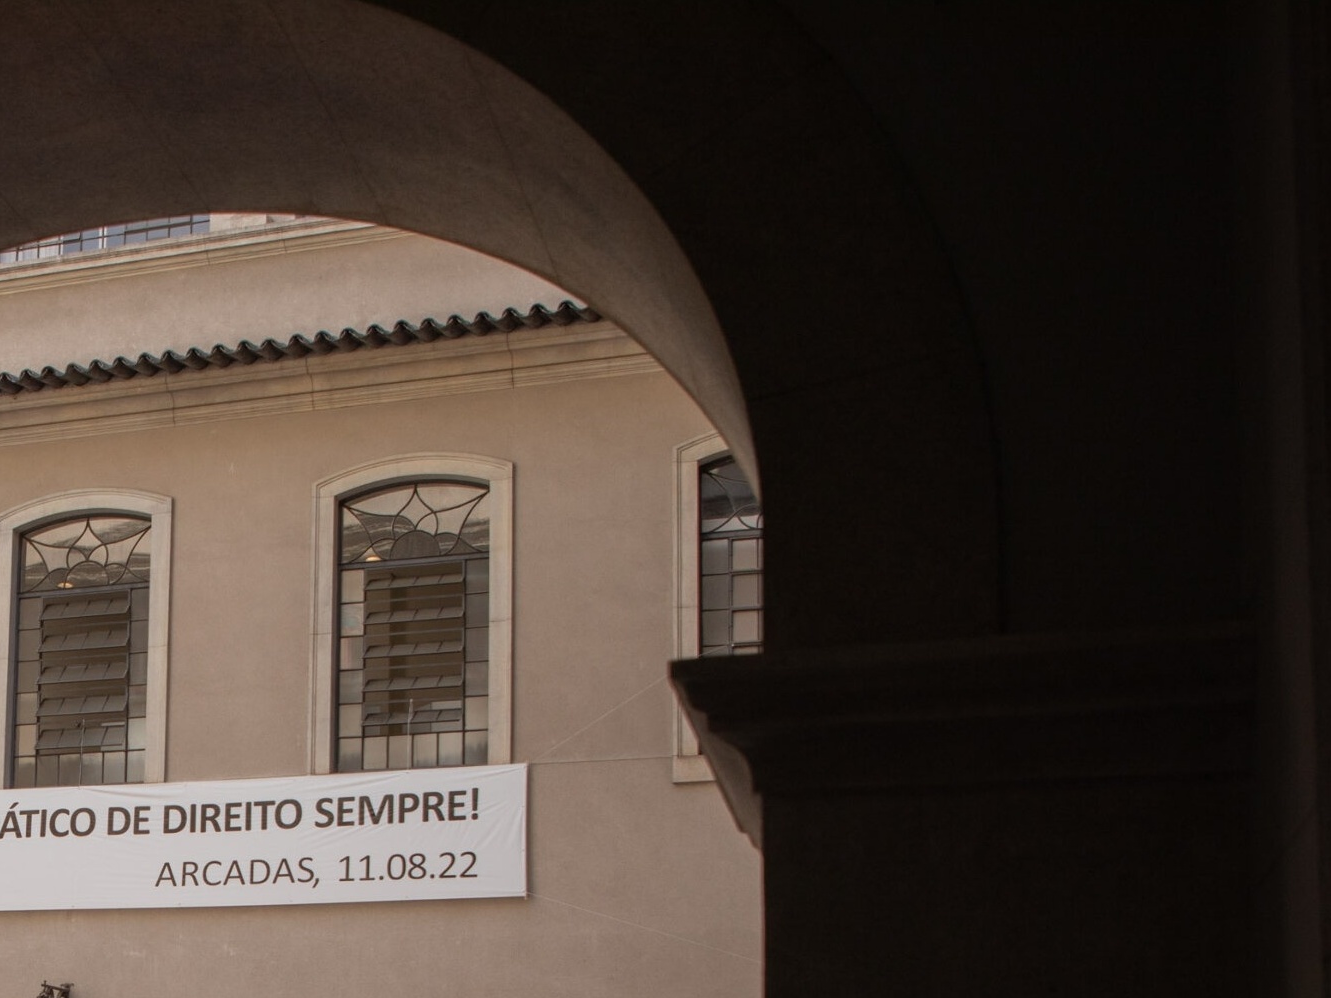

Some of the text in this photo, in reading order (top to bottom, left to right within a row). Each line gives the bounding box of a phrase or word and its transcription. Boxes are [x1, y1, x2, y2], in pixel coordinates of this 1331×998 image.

[106, 805, 152, 836] DE
[163, 798, 303, 835] DIREITO
[314, 787, 480, 829] SEMPRE!
[154, 850, 479, 889] ARCADAS, 11.08.22
